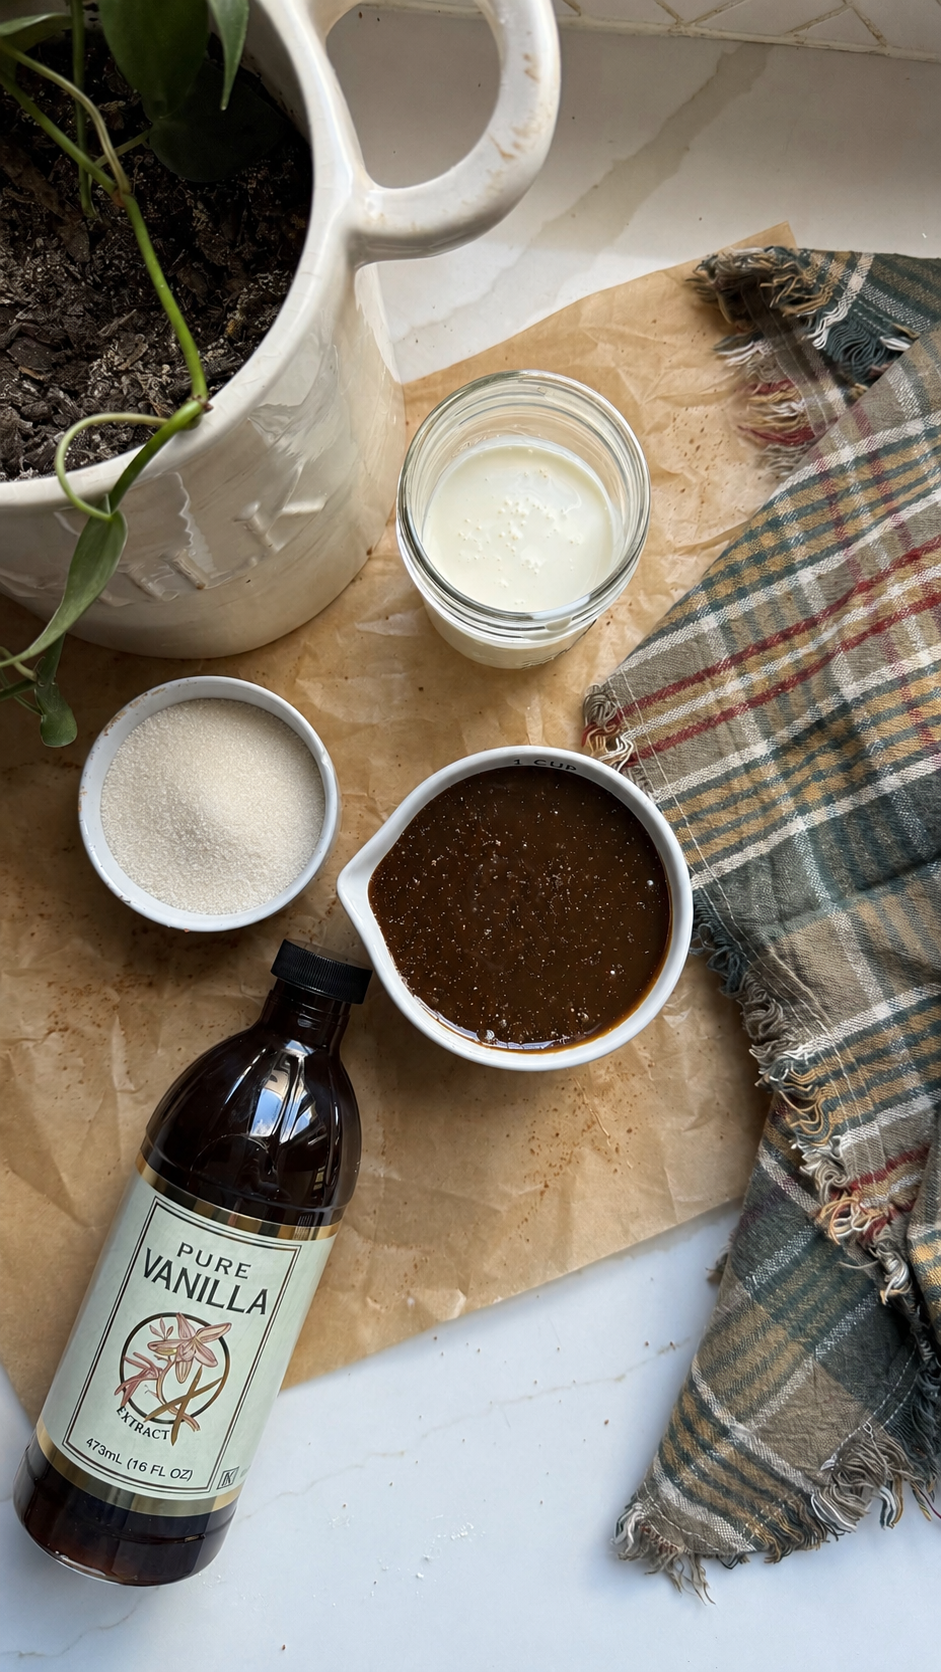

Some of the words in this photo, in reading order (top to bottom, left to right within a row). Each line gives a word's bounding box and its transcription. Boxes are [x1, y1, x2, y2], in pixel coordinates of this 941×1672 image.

[533, 759, 577, 770] CUP
[177, 1242, 252, 1279] PURE
[143, 1247, 268, 1315] VANILLA
[116, 1406, 170, 1440] EXTRACT
[86, 1438, 122, 1464] 473mL
[126, 1458, 147, 1472] (16
[150, 1464, 166, 1477] FL
[170, 1468, 193, 1481] OZ)
